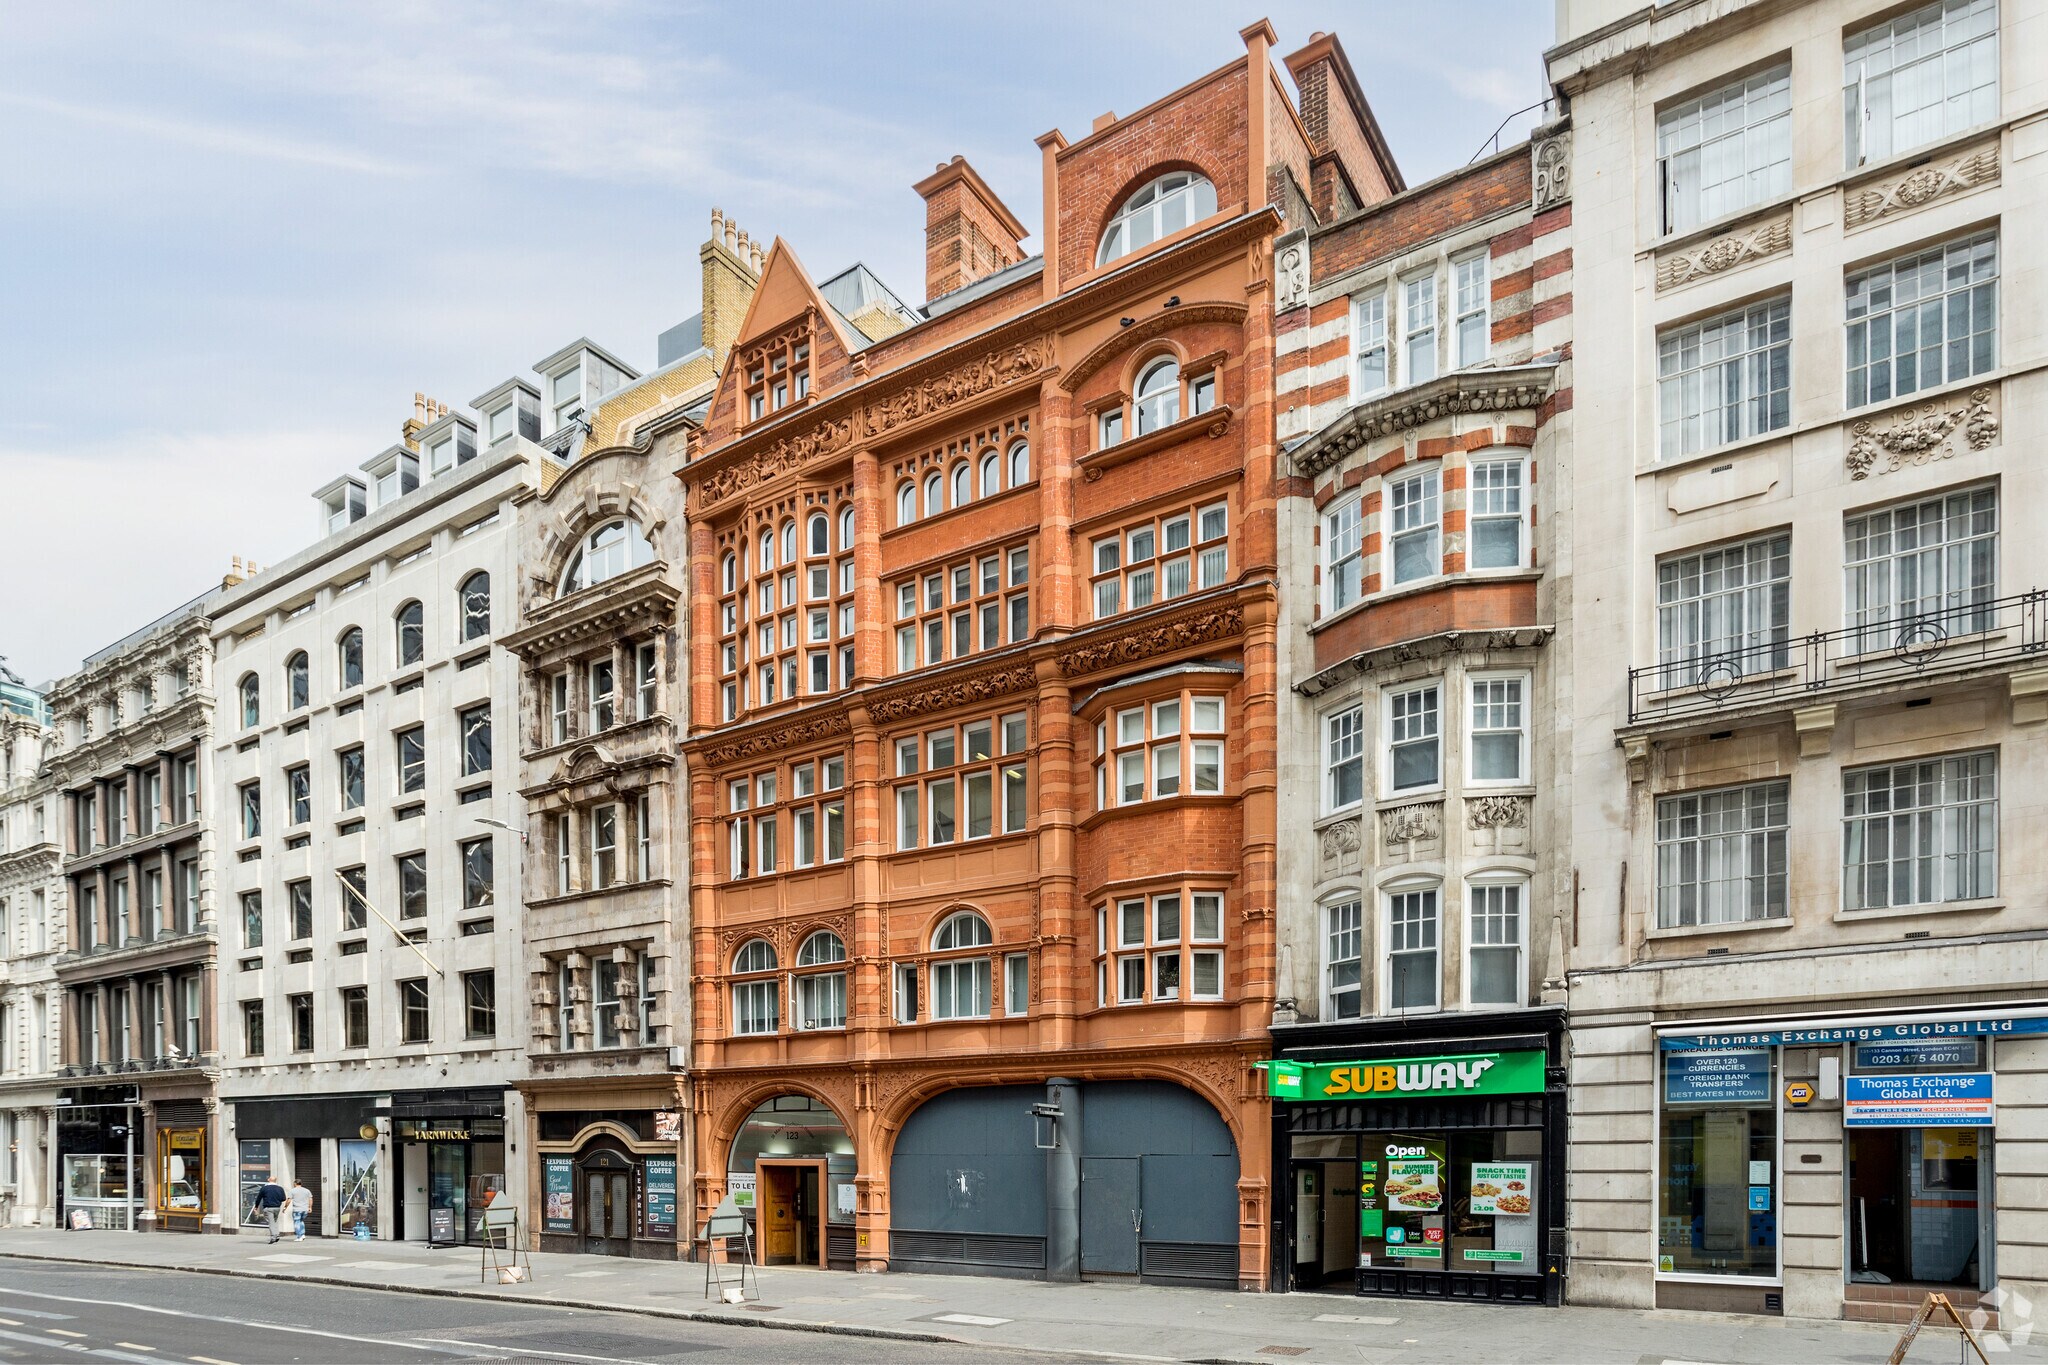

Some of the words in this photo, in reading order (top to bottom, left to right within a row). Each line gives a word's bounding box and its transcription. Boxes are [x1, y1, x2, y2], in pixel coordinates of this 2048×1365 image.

[1891, 400, 1950, 427] 1921
[1697, 1033, 1770, 1046] Thomas
[1782, 1028, 1882, 1041] Exchange
[1895, 1021, 1967, 1035] Global
[1977, 1020, 2013, 1032] Ltd
[1872, 1055, 1900, 1064] 0203
[1902, 1054, 1926, 1064] 475
[1930, 1053, 1960, 1062] 4070
[1688, 1064, 1746, 1072] CURRENCIES
[1278, 1074, 1301, 1086] SUBWAY
[1322, 1058, 1495, 1096] SUBWAY
[1859, 1079, 1908, 1088] Thomas
[1912, 1077, 1976, 1088] Exchange
[1690, 1080, 1744, 1088] TRANSFERS
[1880, 1088, 1922, 1099] Global
[1928, 1088, 1954, 1098] Ltd.
[415, 1130, 470, 1140] YARNWICKE
[786, 1131, 799, 1140] 123
[1385, 1144, 1426, 1159] Open
[860, 1236, 866, 1244] H
